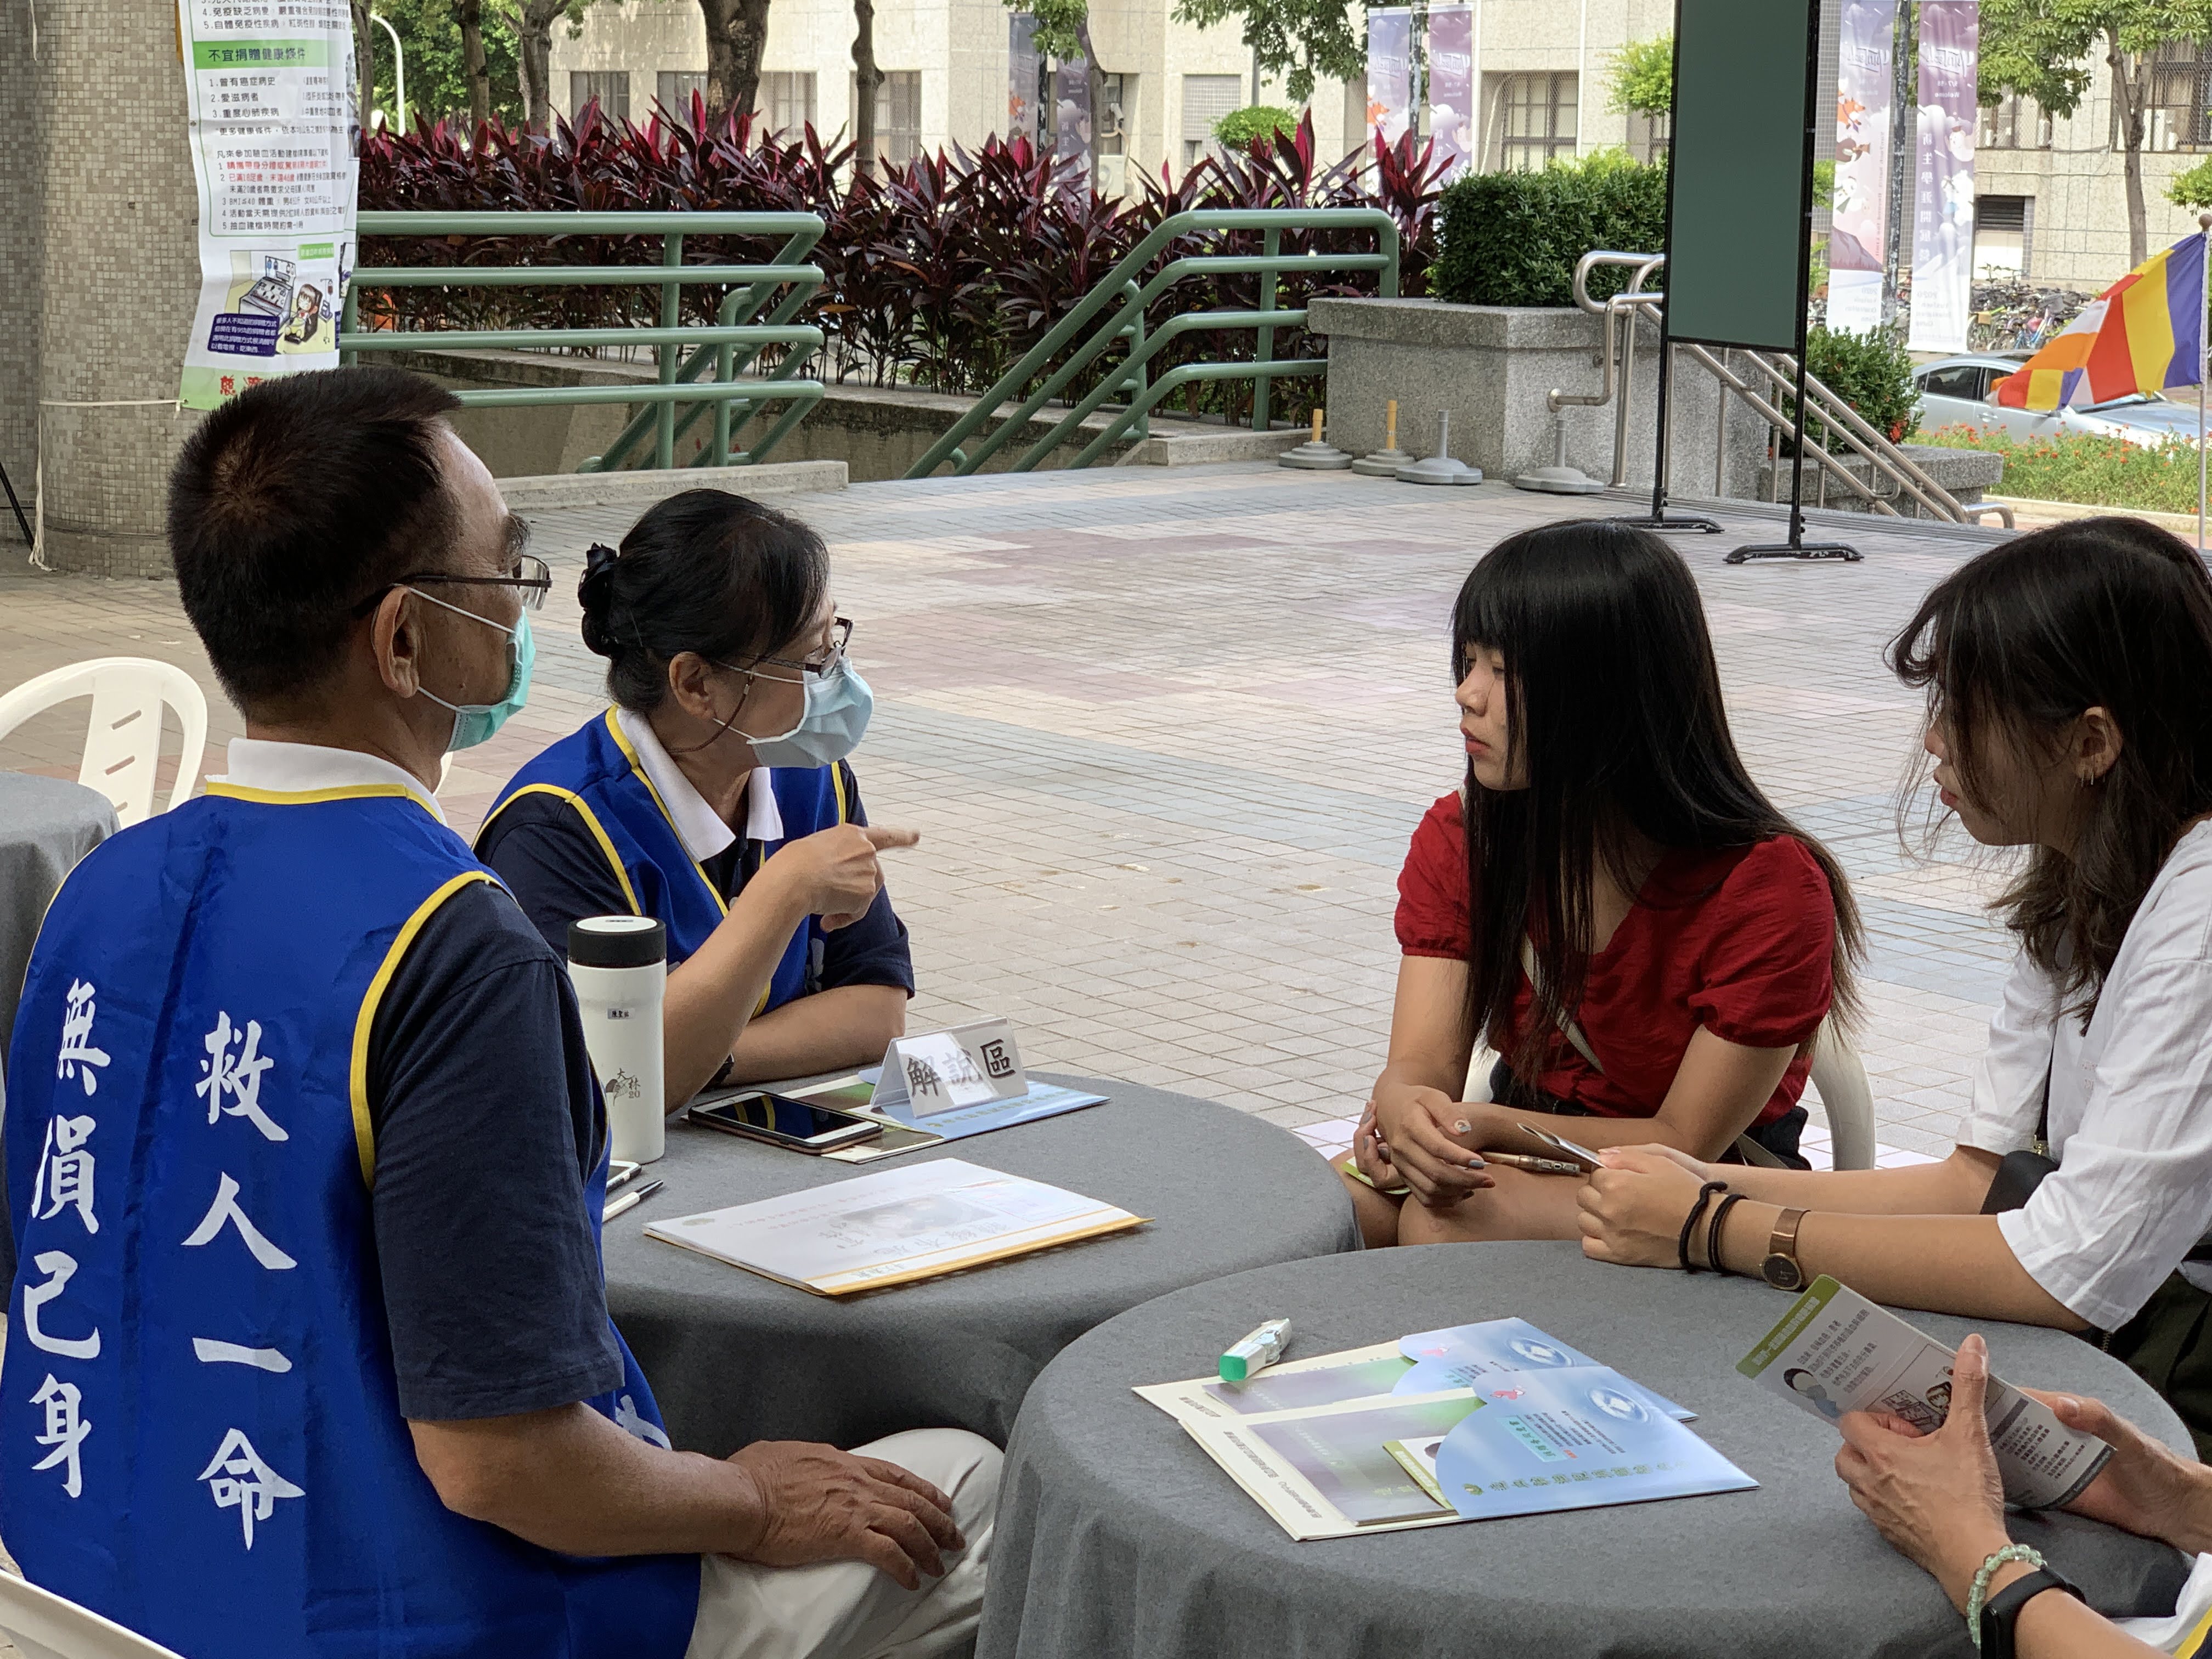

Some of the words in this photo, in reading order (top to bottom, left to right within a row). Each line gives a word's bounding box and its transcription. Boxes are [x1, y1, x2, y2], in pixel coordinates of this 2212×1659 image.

[906, 1038, 1017, 1098] 解說區
[181, 1009, 307, 1551] 救人一命
